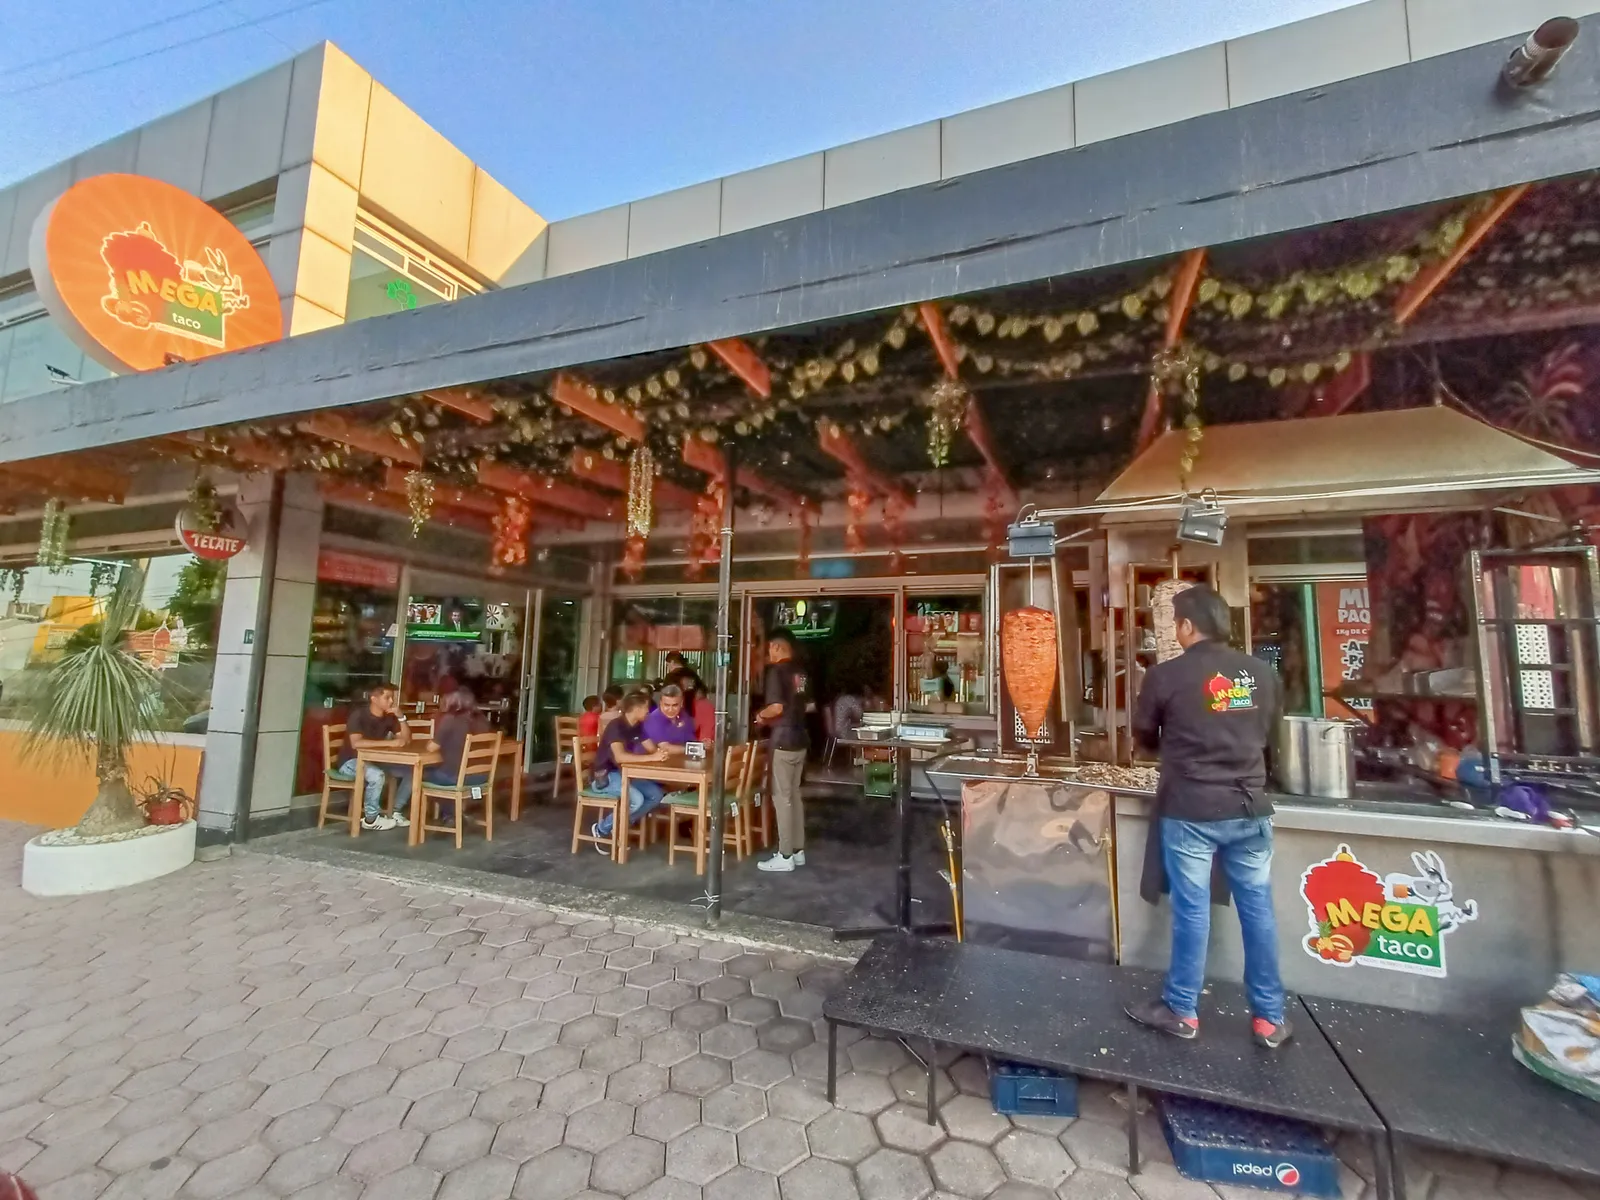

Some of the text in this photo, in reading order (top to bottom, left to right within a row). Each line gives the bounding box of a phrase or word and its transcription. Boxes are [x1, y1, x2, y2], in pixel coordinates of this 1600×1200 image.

[126, 269, 218, 317] MEGA
[172, 312, 201, 330] taco
[191, 533, 240, 552] TECATE
[1217, 688, 1250, 700] MEGA
[1326, 898, 1433, 937] MEGA
[1377, 935, 1434, 960] taco
[1232, 1162, 1273, 1177] pepsi
